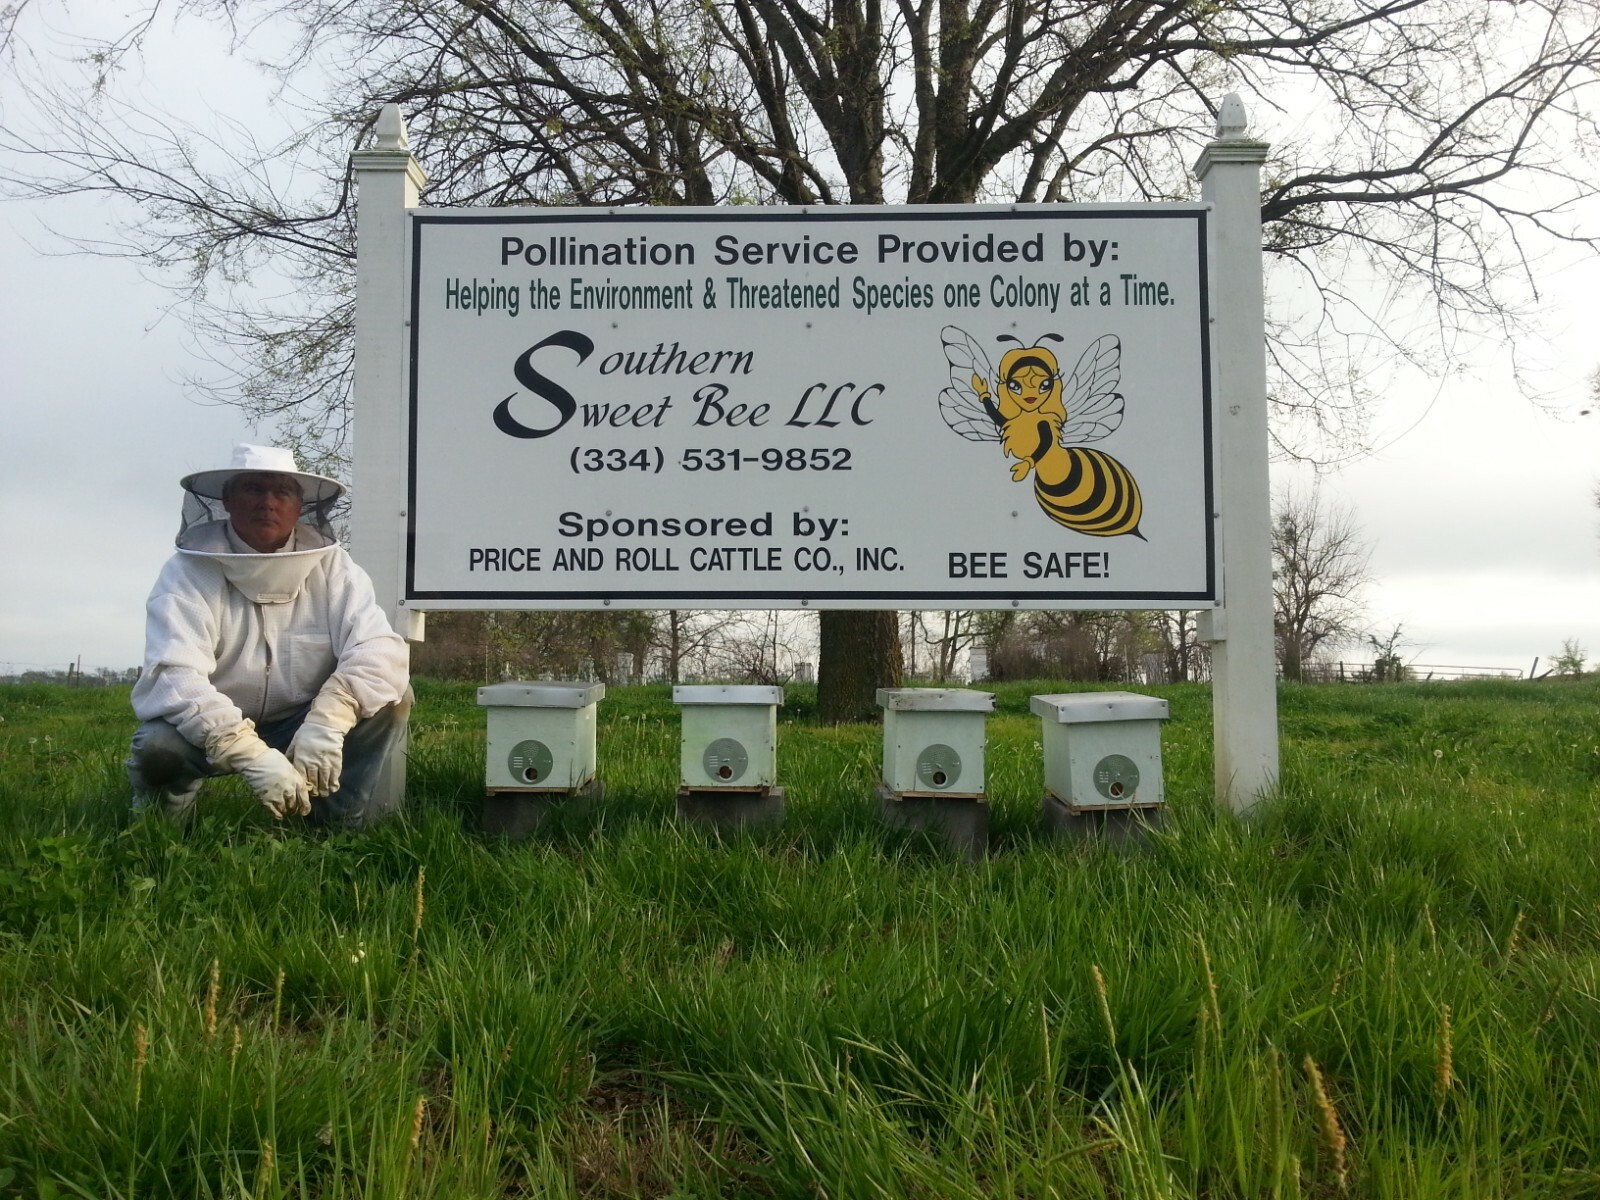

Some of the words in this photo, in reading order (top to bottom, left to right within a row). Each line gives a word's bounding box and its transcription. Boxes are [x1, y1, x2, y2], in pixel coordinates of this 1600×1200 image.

[502, 236, 695, 266] Pollination
[714, 235, 859, 265] Service
[878, 233, 1044, 263] Provided
[1063, 233, 1119, 267] by:
[445, 278, 520, 317] Helping
[529, 278, 561, 310] the
[570, 278, 693, 309] Environment
[703, 277, 717, 309] &
[726, 277, 840, 309] Threatened
[852, 276, 934, 315] Species
[943, 284, 981, 308] one
[990, 275, 1061, 313] Colony
[1070, 276, 1090, 306] at
[1100, 282, 1111, 306] a
[1120, 274, 1175, 306] Time.
[692, 383, 771, 427] Bee
[784, 382, 886, 428] LLC
[570, 446, 665, 474] (334)
[681, 447, 852, 471] 531-9852
[558, 511, 773, 541] Sponsored
[793, 512, 849, 541] by:
[469, 547, 541, 572] PRICE
[552, 547, 604, 572] AND
[615, 547, 680, 572] ROLL
[689, 547, 783, 572] CATTLE
[793, 546, 844, 576] CO.,
[856, 546, 905, 572] INC.
[948, 552, 1008, 579] BEE
[1022, 551, 1110, 579] SAFE!
